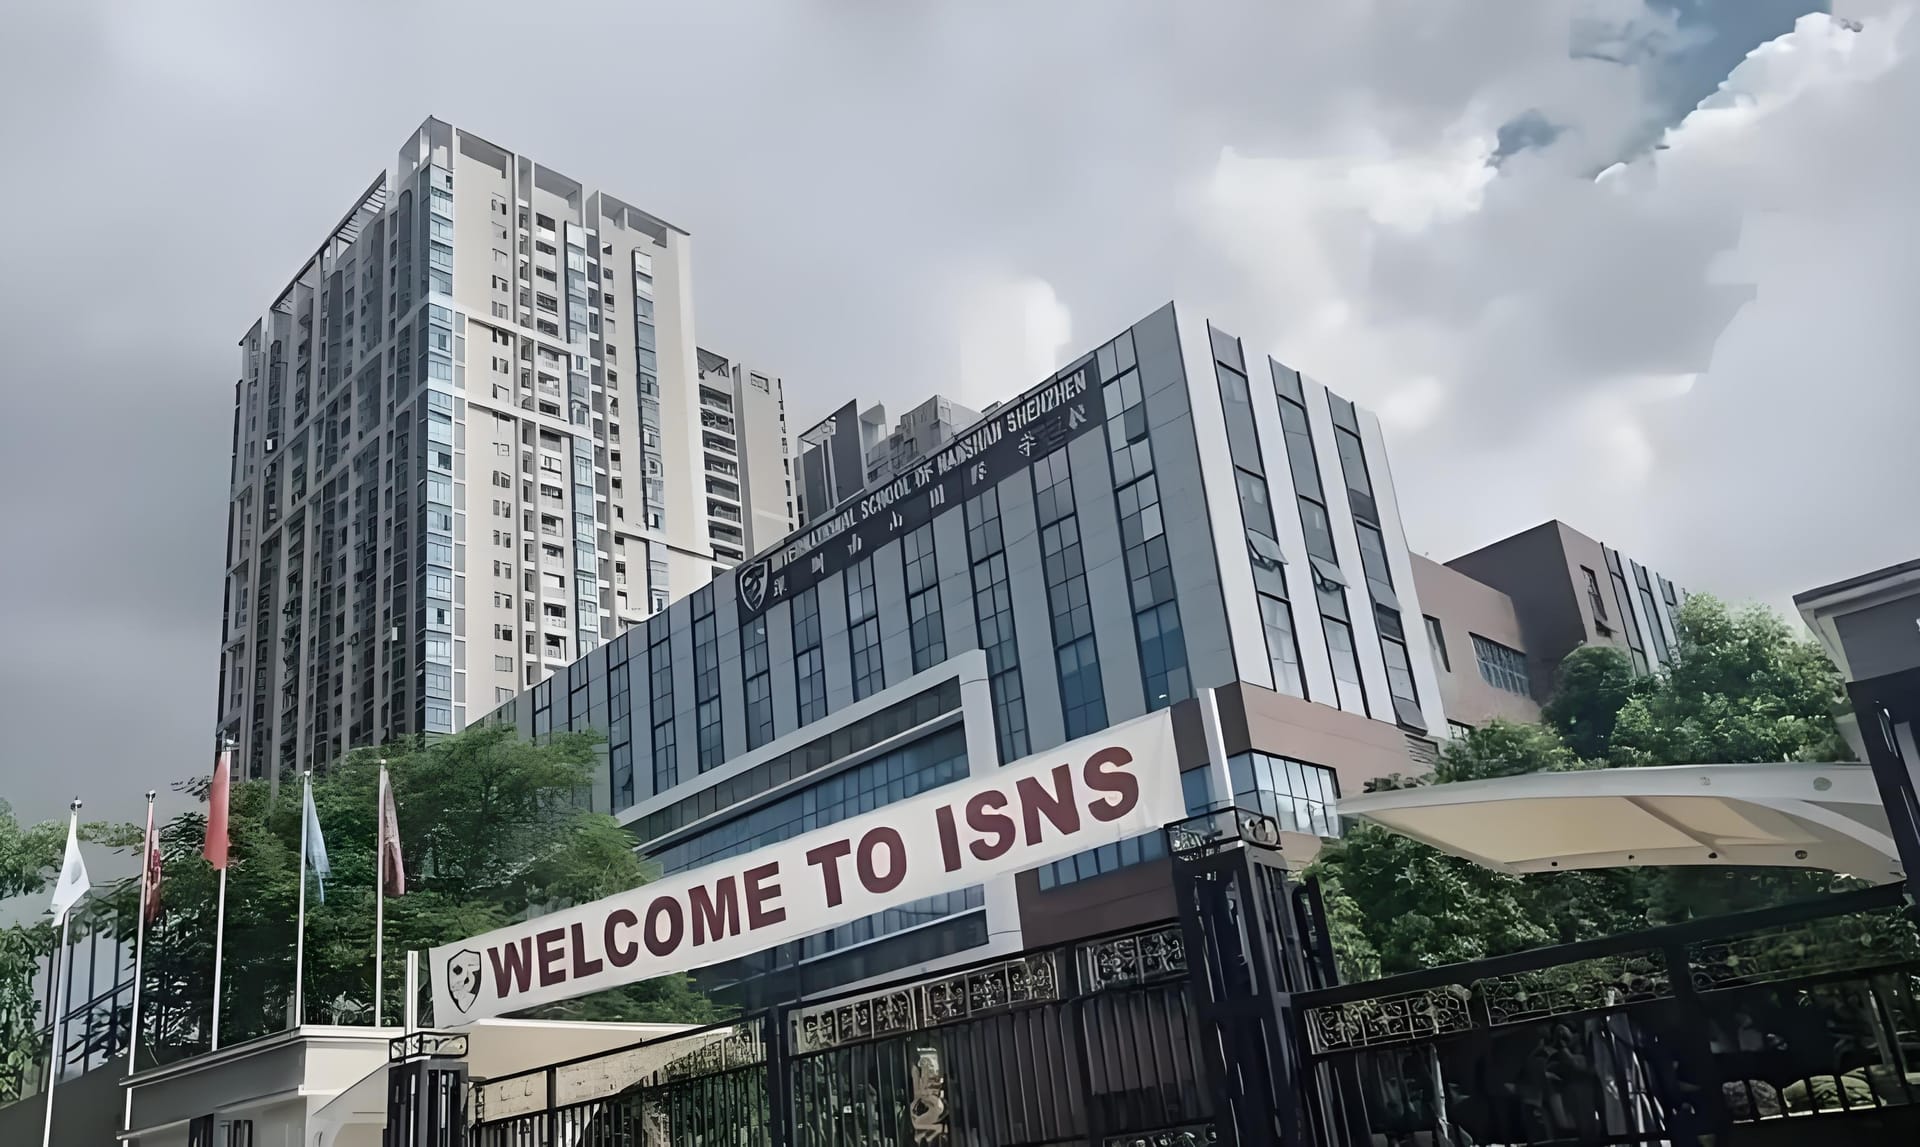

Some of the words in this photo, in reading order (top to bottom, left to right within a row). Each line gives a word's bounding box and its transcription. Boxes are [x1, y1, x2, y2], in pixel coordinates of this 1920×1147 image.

[487, 862, 787, 999] WELCOME
[806, 826, 907, 909] TO
[935, 746, 1140, 872] ISNS
